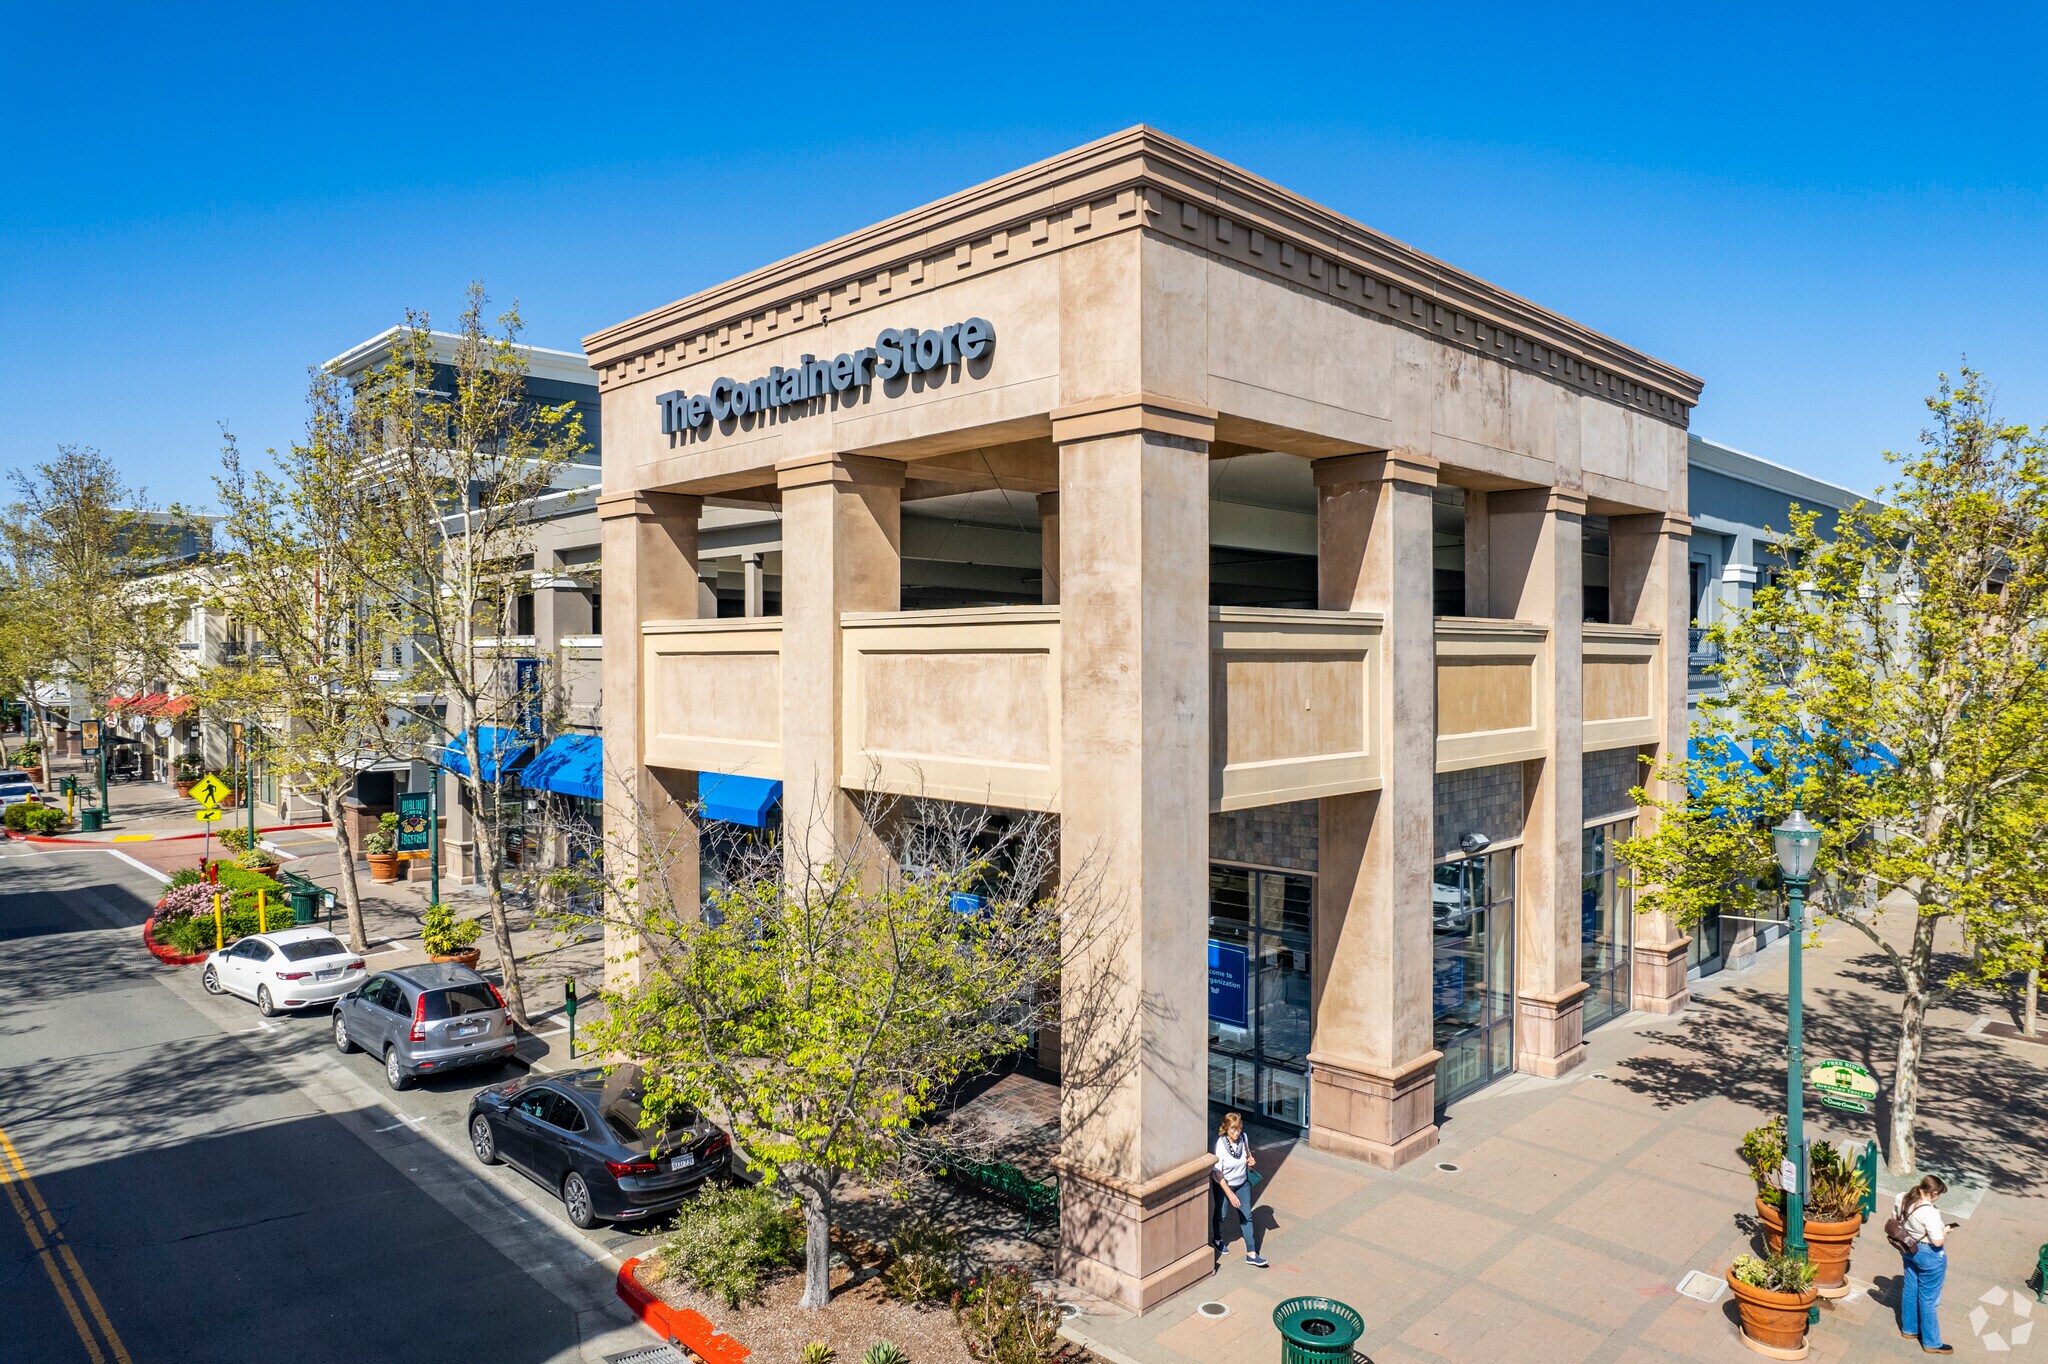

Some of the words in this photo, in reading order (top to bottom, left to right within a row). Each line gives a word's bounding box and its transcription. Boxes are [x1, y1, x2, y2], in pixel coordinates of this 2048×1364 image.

[656, 389, 713, 434] The
[709, 346, 876, 422] Container
[874, 316, 995, 380] Store
[402, 799, 426, 813] WALNUT
[401, 832, 426, 844] TOGETHER
[1209, 969, 1225, 977] come
[1845, 1063, 1861, 1071] RIDE
[1846, 1089, 1872, 1098] TROLLEY
